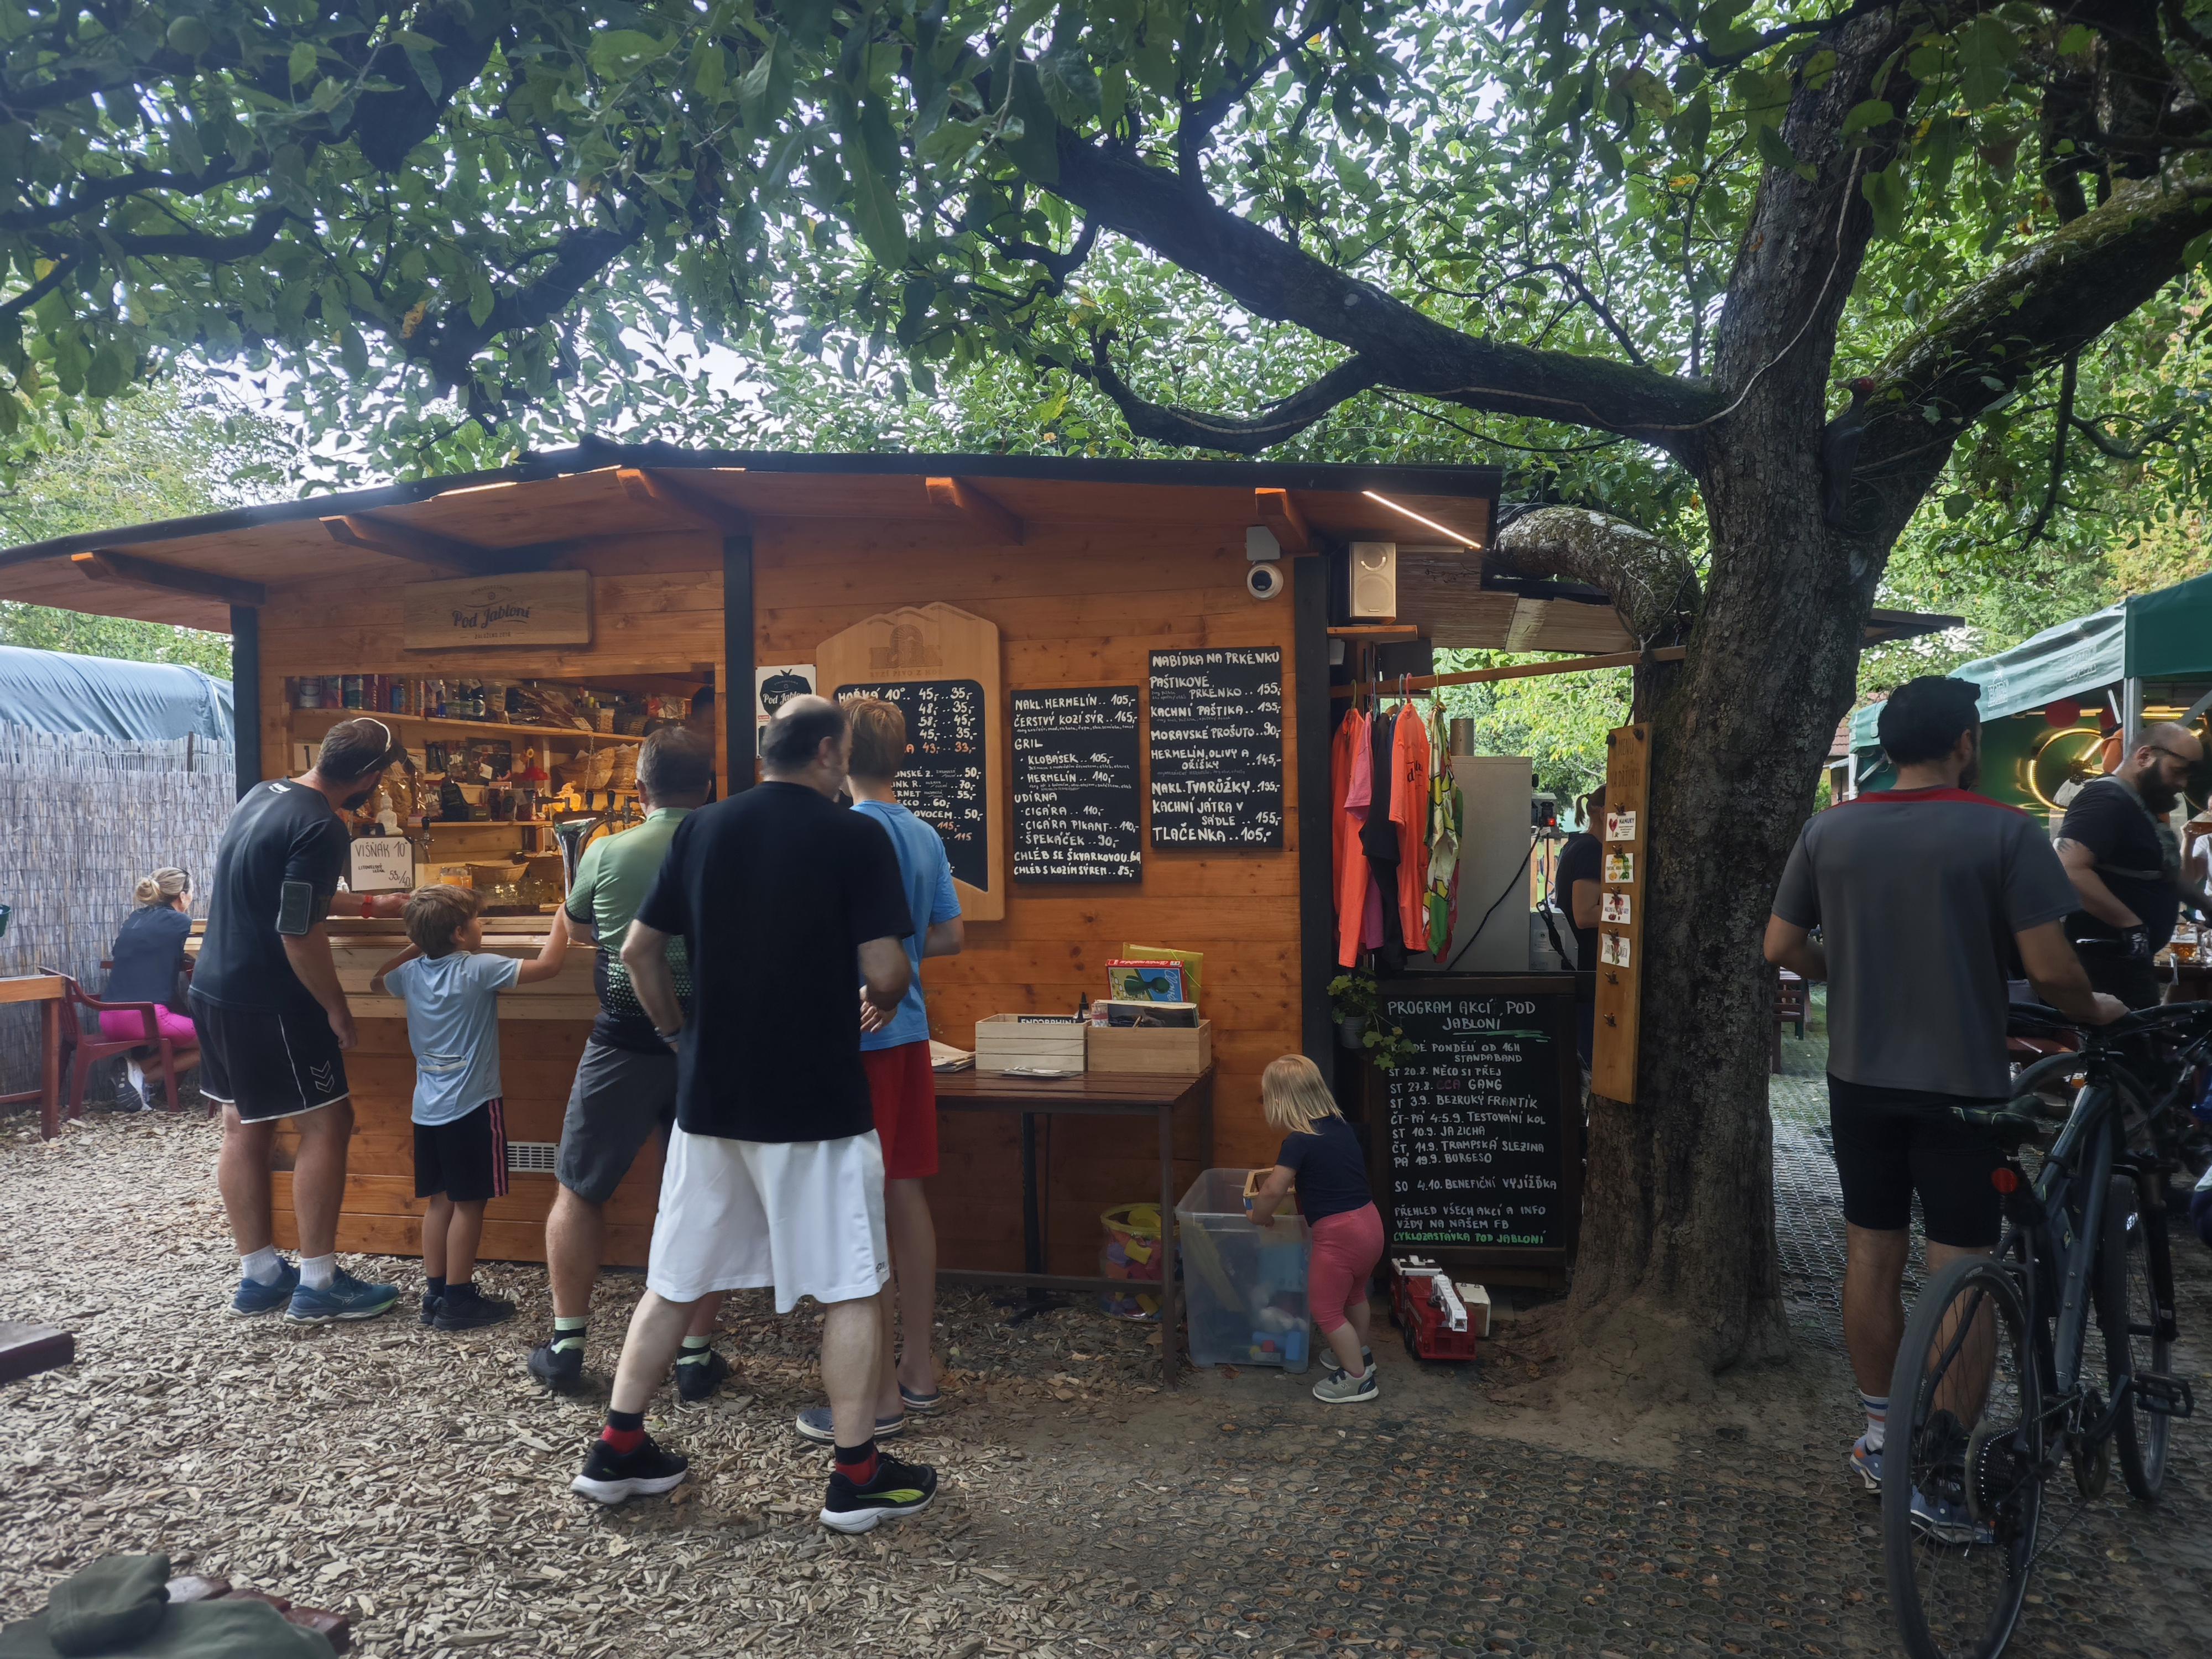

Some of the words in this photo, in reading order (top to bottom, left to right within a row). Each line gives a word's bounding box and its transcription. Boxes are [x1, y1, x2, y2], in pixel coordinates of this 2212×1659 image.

[452, 610, 478, 629] Pod
[1152, 651, 1204, 667] NABÍDKA
[1206, 653, 1223, 664] NA
[1224, 650, 1280, 665] PRKÉNKU
[1149, 670, 1210, 689] PAŠTIKOVÉ
[763, 693, 778, 705] Pod
[1189, 684, 1242, 700] PRKÉNKO
[1015, 699, 1044, 711] NAKL.
[1045, 693, 1097, 709] HERMELÍN
[1150, 702, 1193, 717] KACHNÍ
[1197, 702, 1244, 717] PAŠTIKA
[1014, 711, 1055, 728] ČERSTVÝ
[1059, 711, 1083, 724] KOZÍ
[1085, 710, 1103, 723] SÝR
[1150, 725, 1209, 741] MORAVSKÉ
[1211, 724, 1254, 739] PROŠUTO
[1014, 738, 1043, 750] GRIL
[1028, 750, 1078, 765] KLOBÁSEK
[1209, 749, 1237, 759] OLIVY
[1241, 749, 1249, 758] A
[1182, 758, 1219, 770] OŘÍŠKY
[1027, 770, 1076, 783] HERMELÍN
[1151, 782, 1186, 796] NAKL.
[1185, 776, 1250, 795] TVARŮŽKY
[1014, 791, 1057, 803] UDÍRNA
[1152, 796, 1194, 813] KACHNÍ
[1197, 797, 1232, 813] JÁTRA
[1236, 801, 1244, 811] V
[1025, 804, 1067, 816] CIGÁRA
[1025, 817, 1066, 830] CIGÁRA
[1070, 820, 1109, 832] PIKANT
[1201, 814, 1235, 826] SÁDLE
[1025, 831, 1084, 846] ŠPEKÁČEK
[1152, 822, 1225, 842] TLAČENKA
[355, 841, 390, 857] VIŠŇÁK
[1014, 847, 1050, 862] CHLÉB
[1014, 863, 1041, 875] CHLÉB
[1043, 866, 1048, 874] S
[1050, 863, 1077, 874] KOZÍM
[1078, 863, 1107, 875] SÝREM
[1387, 1000, 1452, 1015] PROGRAM
[1459, 998, 1494, 1015] AKCÍ
[1505, 1000, 1536, 1015] POD
[1442, 1013, 1504, 1031] JABLONÍ
[1432, 1040, 1477, 1052] PONDĚLÍ
[1502, 1042, 1521, 1052] 16H
[1389, 1068, 1400, 1077] ST
[1404, 1067, 1428, 1076] 20.8.
[1433, 1065, 1458, 1076] NĚCO
[1461, 1068, 1472, 1076] SI
[1475, 1065, 1501, 1076] PŘEJ
[1390, 1083, 1403, 1094] ST
[1407, 1082, 1433, 1093] 27.8.
[1468, 1079, 1503, 1091] GANG
[1390, 1099, 1404, 1109] ST
[1410, 1095, 1431, 1106] 3.9.
[1436, 1091, 1484, 1106] BEZRUKÝ
[1487, 1094, 1538, 1109] FRANTÍK
[1467, 1109, 1524, 1124] TESTOVÁNÍ
[1527, 1115, 1546, 1125] KOL
[1392, 1128, 1406, 1139] ST
[1411, 1127, 1436, 1137] 10.9.
[1415, 1141, 1438, 1152] 11.9.
[1441, 1136, 1499, 1151] TRAMPSKÁ
[1502, 1141, 1545, 1153] SLEZINA
[1394, 1152, 1410, 1168] PÁ
[1415, 1154, 1441, 1165] 19.9.
[1395, 1181, 1408, 1192] SO
[1417, 1179, 1443, 1191] 4.10.
[1445, 1176, 1496, 1190] BENEFIČNÍ
[1502, 1174, 1557, 1190] VYJÍŽĎKA
[1394, 1204, 1437, 1217] PŘEHLED
[1443, 1202, 1474, 1217] VŠECH
[1477, 1203, 1503, 1217] AKCÍ
[1506, 1207, 1514, 1215] A
[1520, 1206, 1546, 1215] INFO
[1396, 1218, 1423, 1230] VŽDY
[1430, 1220, 1444, 1229] NA
[1449, 1217, 1489, 1229] NAŠEM
[1494, 1219, 1509, 1229] FB
[1394, 1229, 1470, 1242] CYKLOZASTÁVKA
[1475, 1233, 1493, 1243] POD
[1496, 1230, 1547, 1244] JABLONÍ
